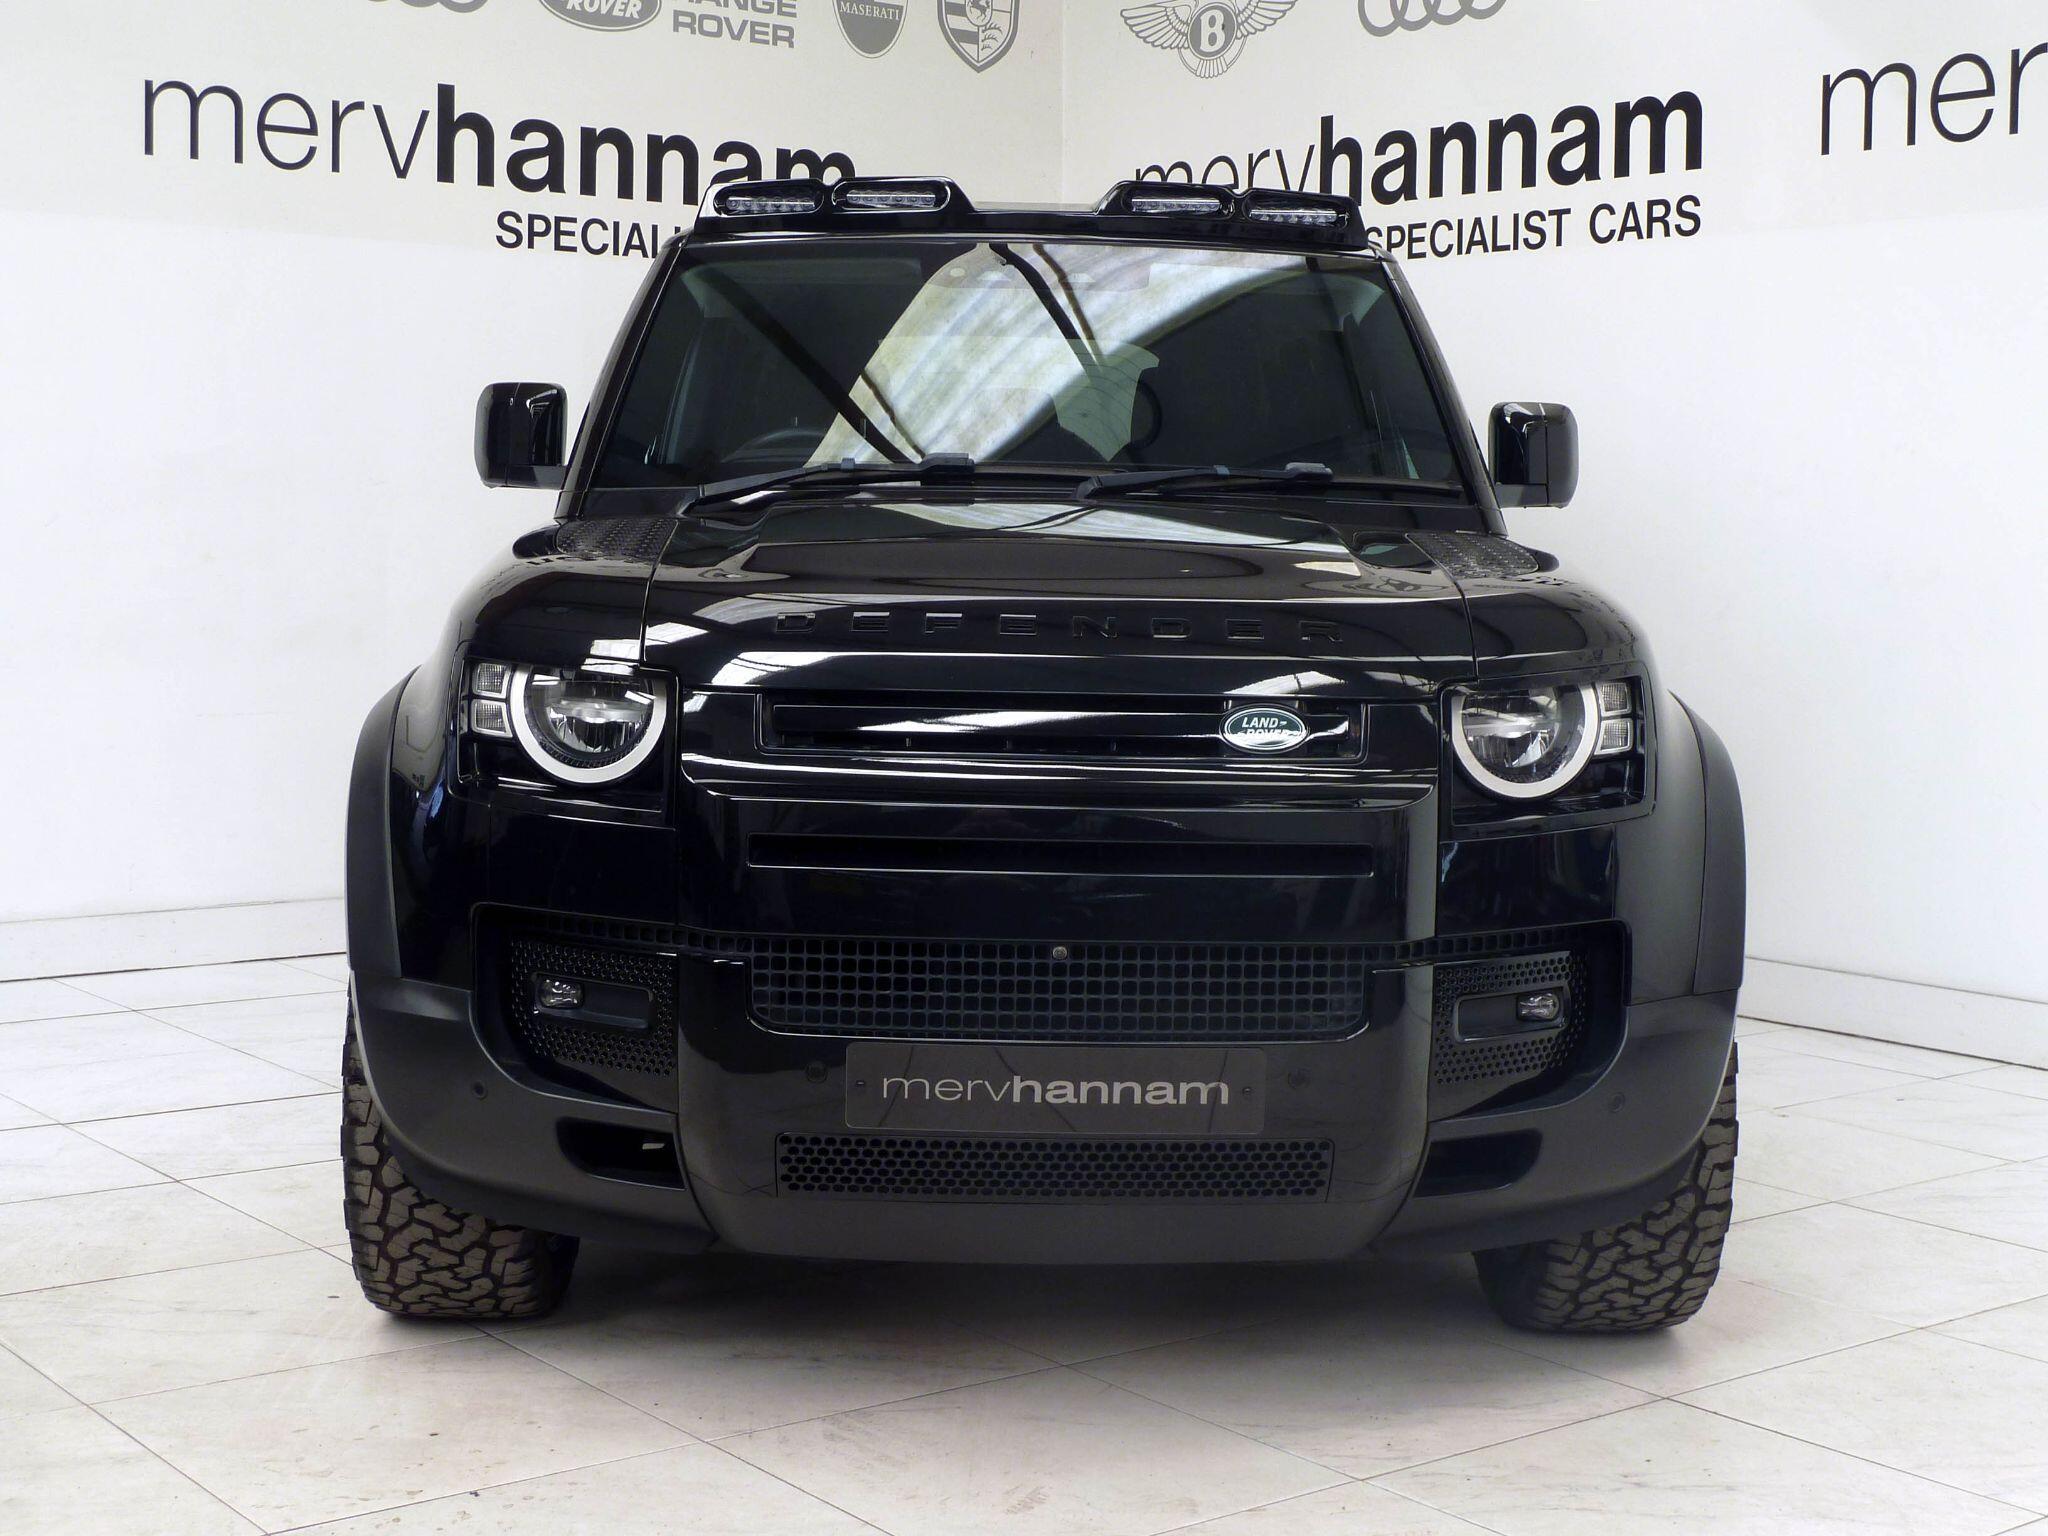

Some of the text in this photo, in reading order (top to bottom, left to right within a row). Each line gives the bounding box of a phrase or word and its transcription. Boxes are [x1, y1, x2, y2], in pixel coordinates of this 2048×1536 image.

[673, 9, 795, 48] ROVER
[840, 2, 901, 21] MASERATI
[1135, 90, 1703, 206] ervhannam
[495, 210, 682, 259] SPECIAL
[1588, 194, 1702, 245] CARS
[776, 611, 1344, 642] DEFENDER
[882, 1075, 1229, 1105] mervhannam
